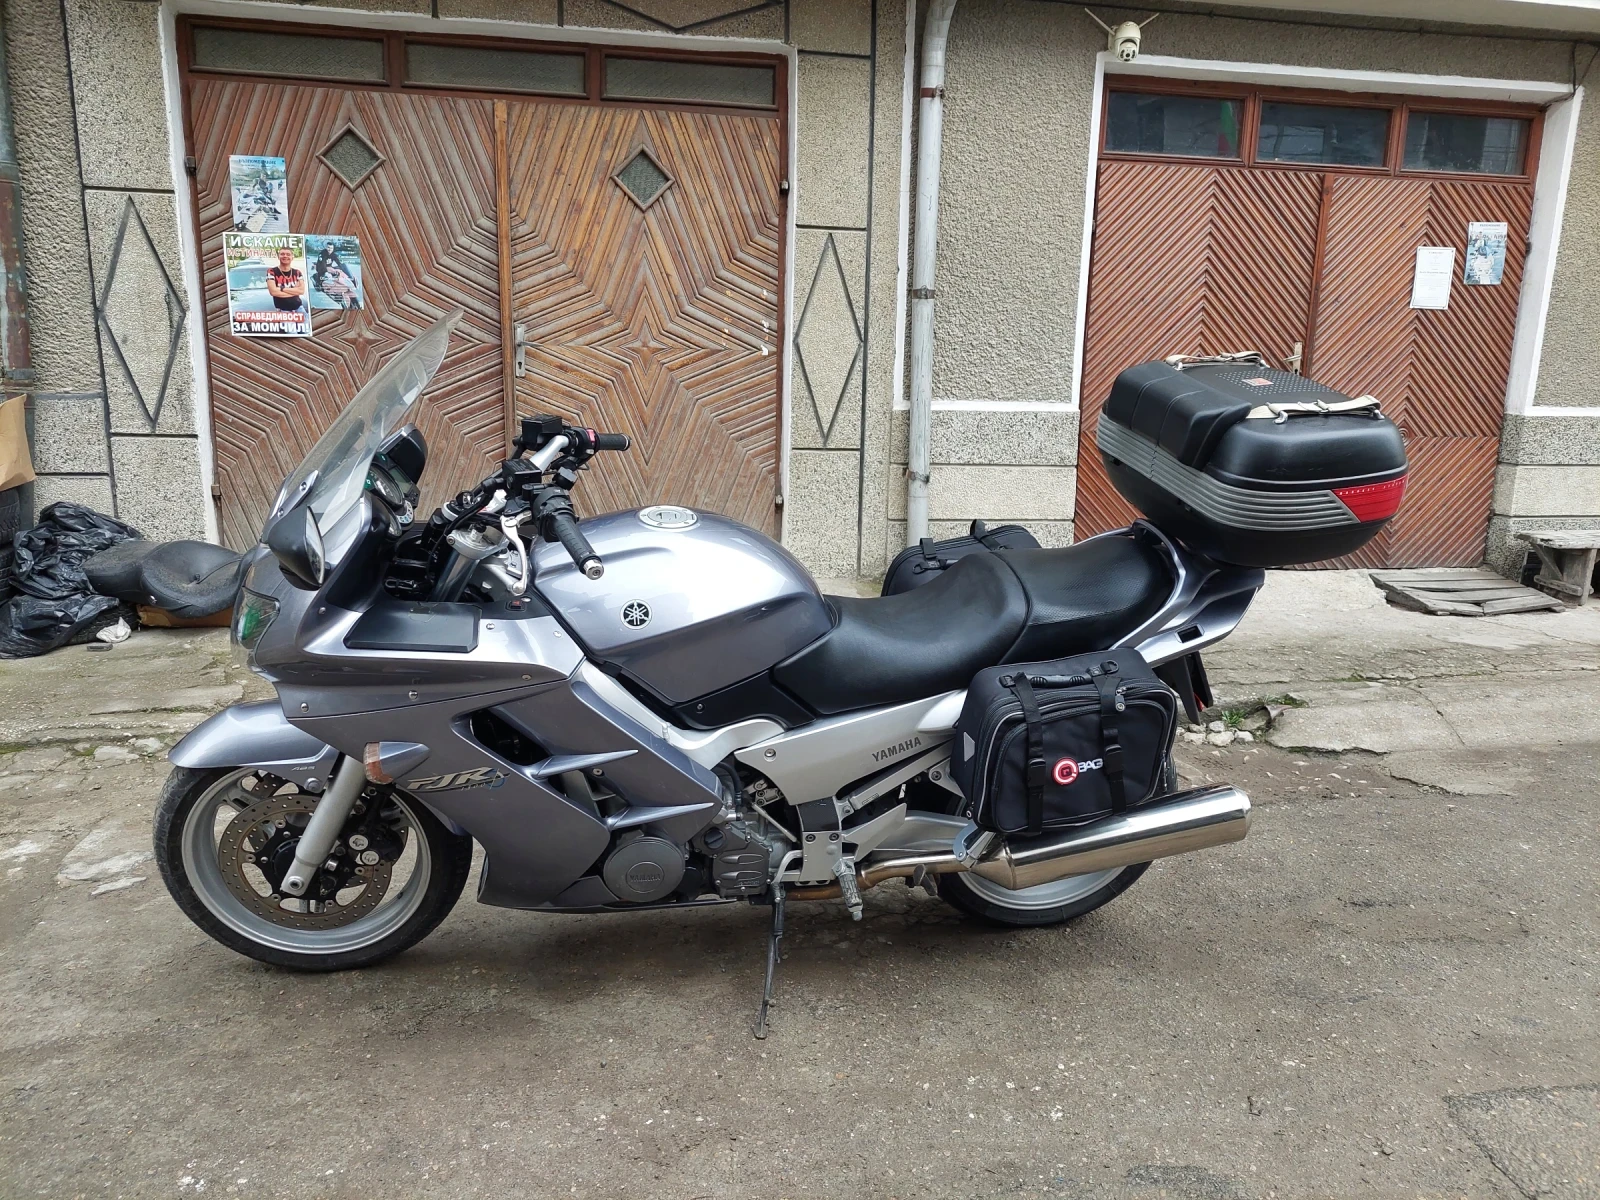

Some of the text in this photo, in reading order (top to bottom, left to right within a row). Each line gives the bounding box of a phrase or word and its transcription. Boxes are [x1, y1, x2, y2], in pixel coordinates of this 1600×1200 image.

[227, 247, 278, 258] ИСТИНАТА
[236, 312, 304, 322] СПРАВЕДЛИВОСТ
[233, 321, 310, 333] ЗА МОМЧИЛ!
[871, 736, 922, 762] YAMAHA
[629, 873, 661, 882] YAMAHA
